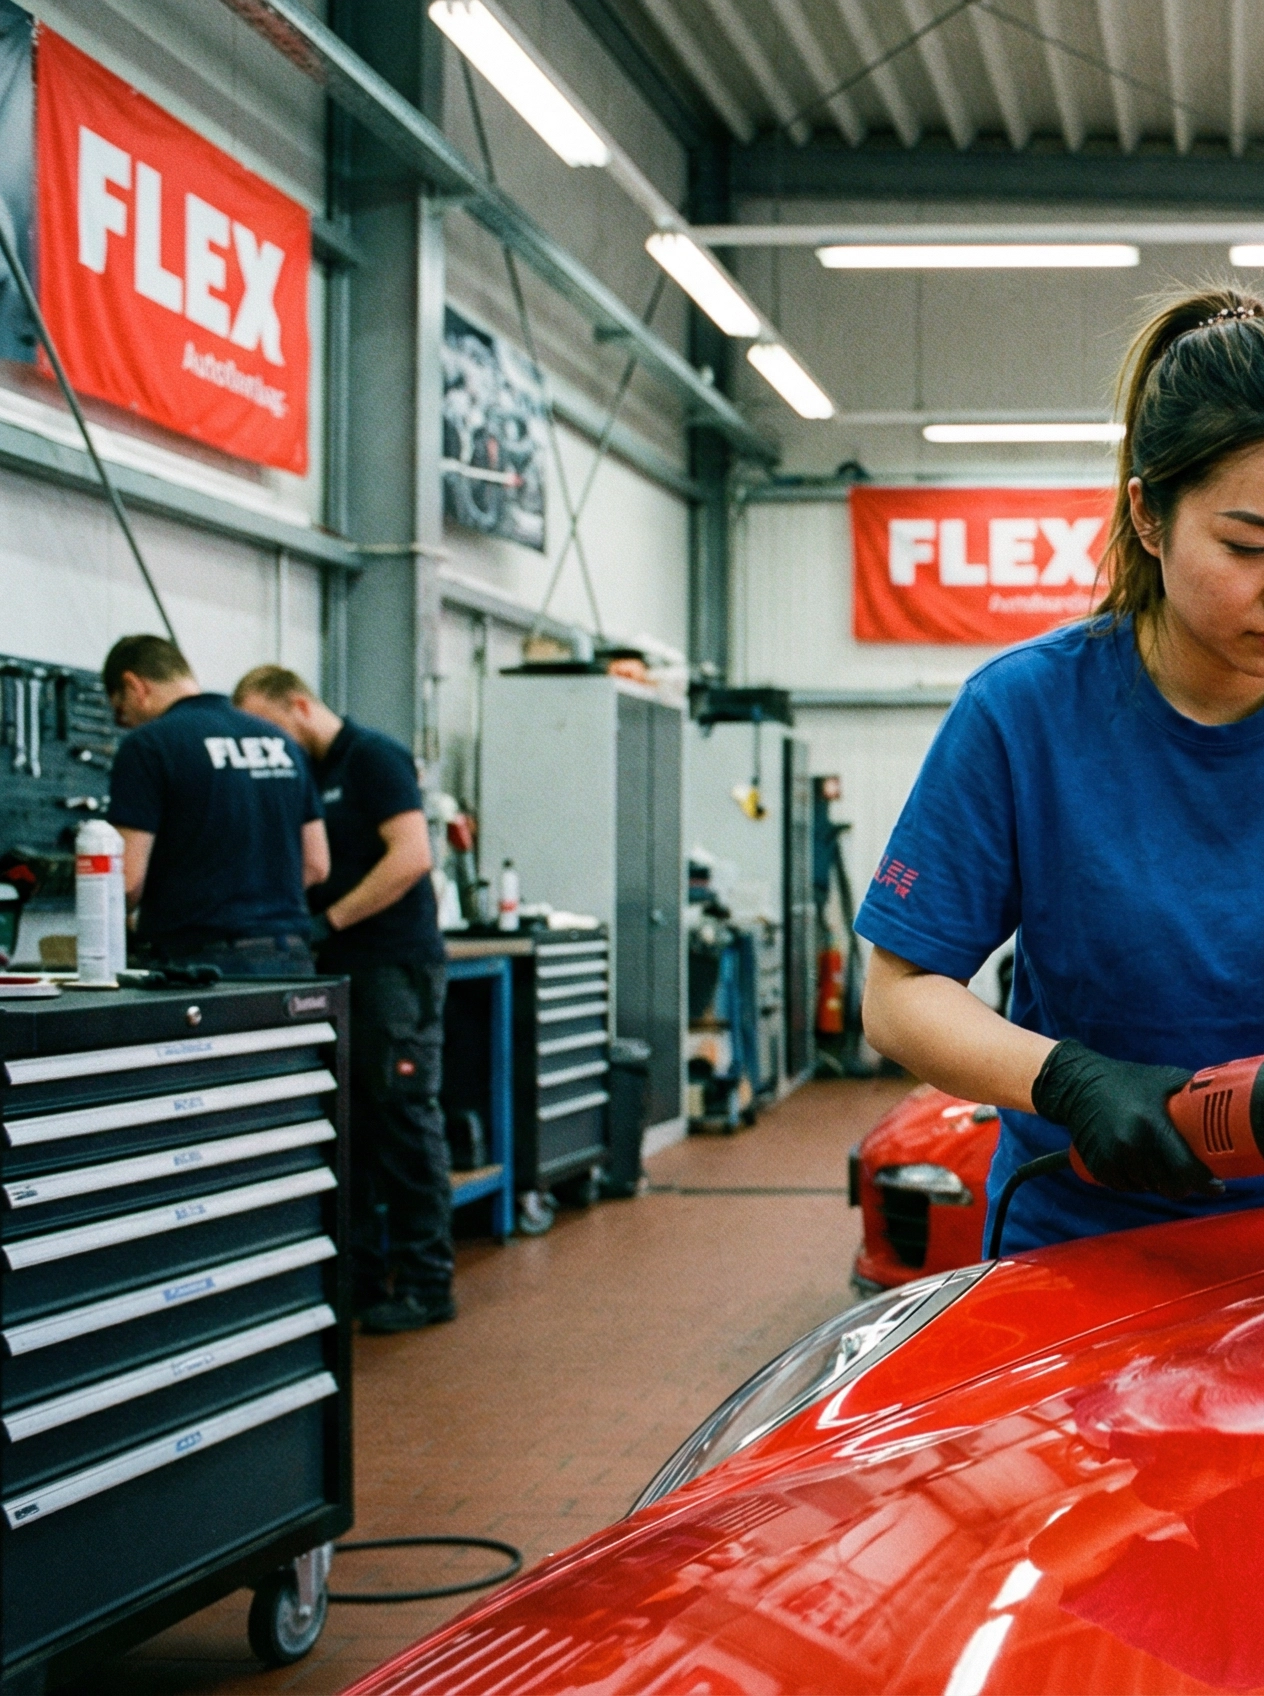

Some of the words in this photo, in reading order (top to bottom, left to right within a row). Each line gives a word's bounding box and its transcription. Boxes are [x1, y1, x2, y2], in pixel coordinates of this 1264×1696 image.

[77, 124, 286, 367] FLEX
[888, 517, 1109, 586] FLEX
[204, 737, 294, 769] FLEX
